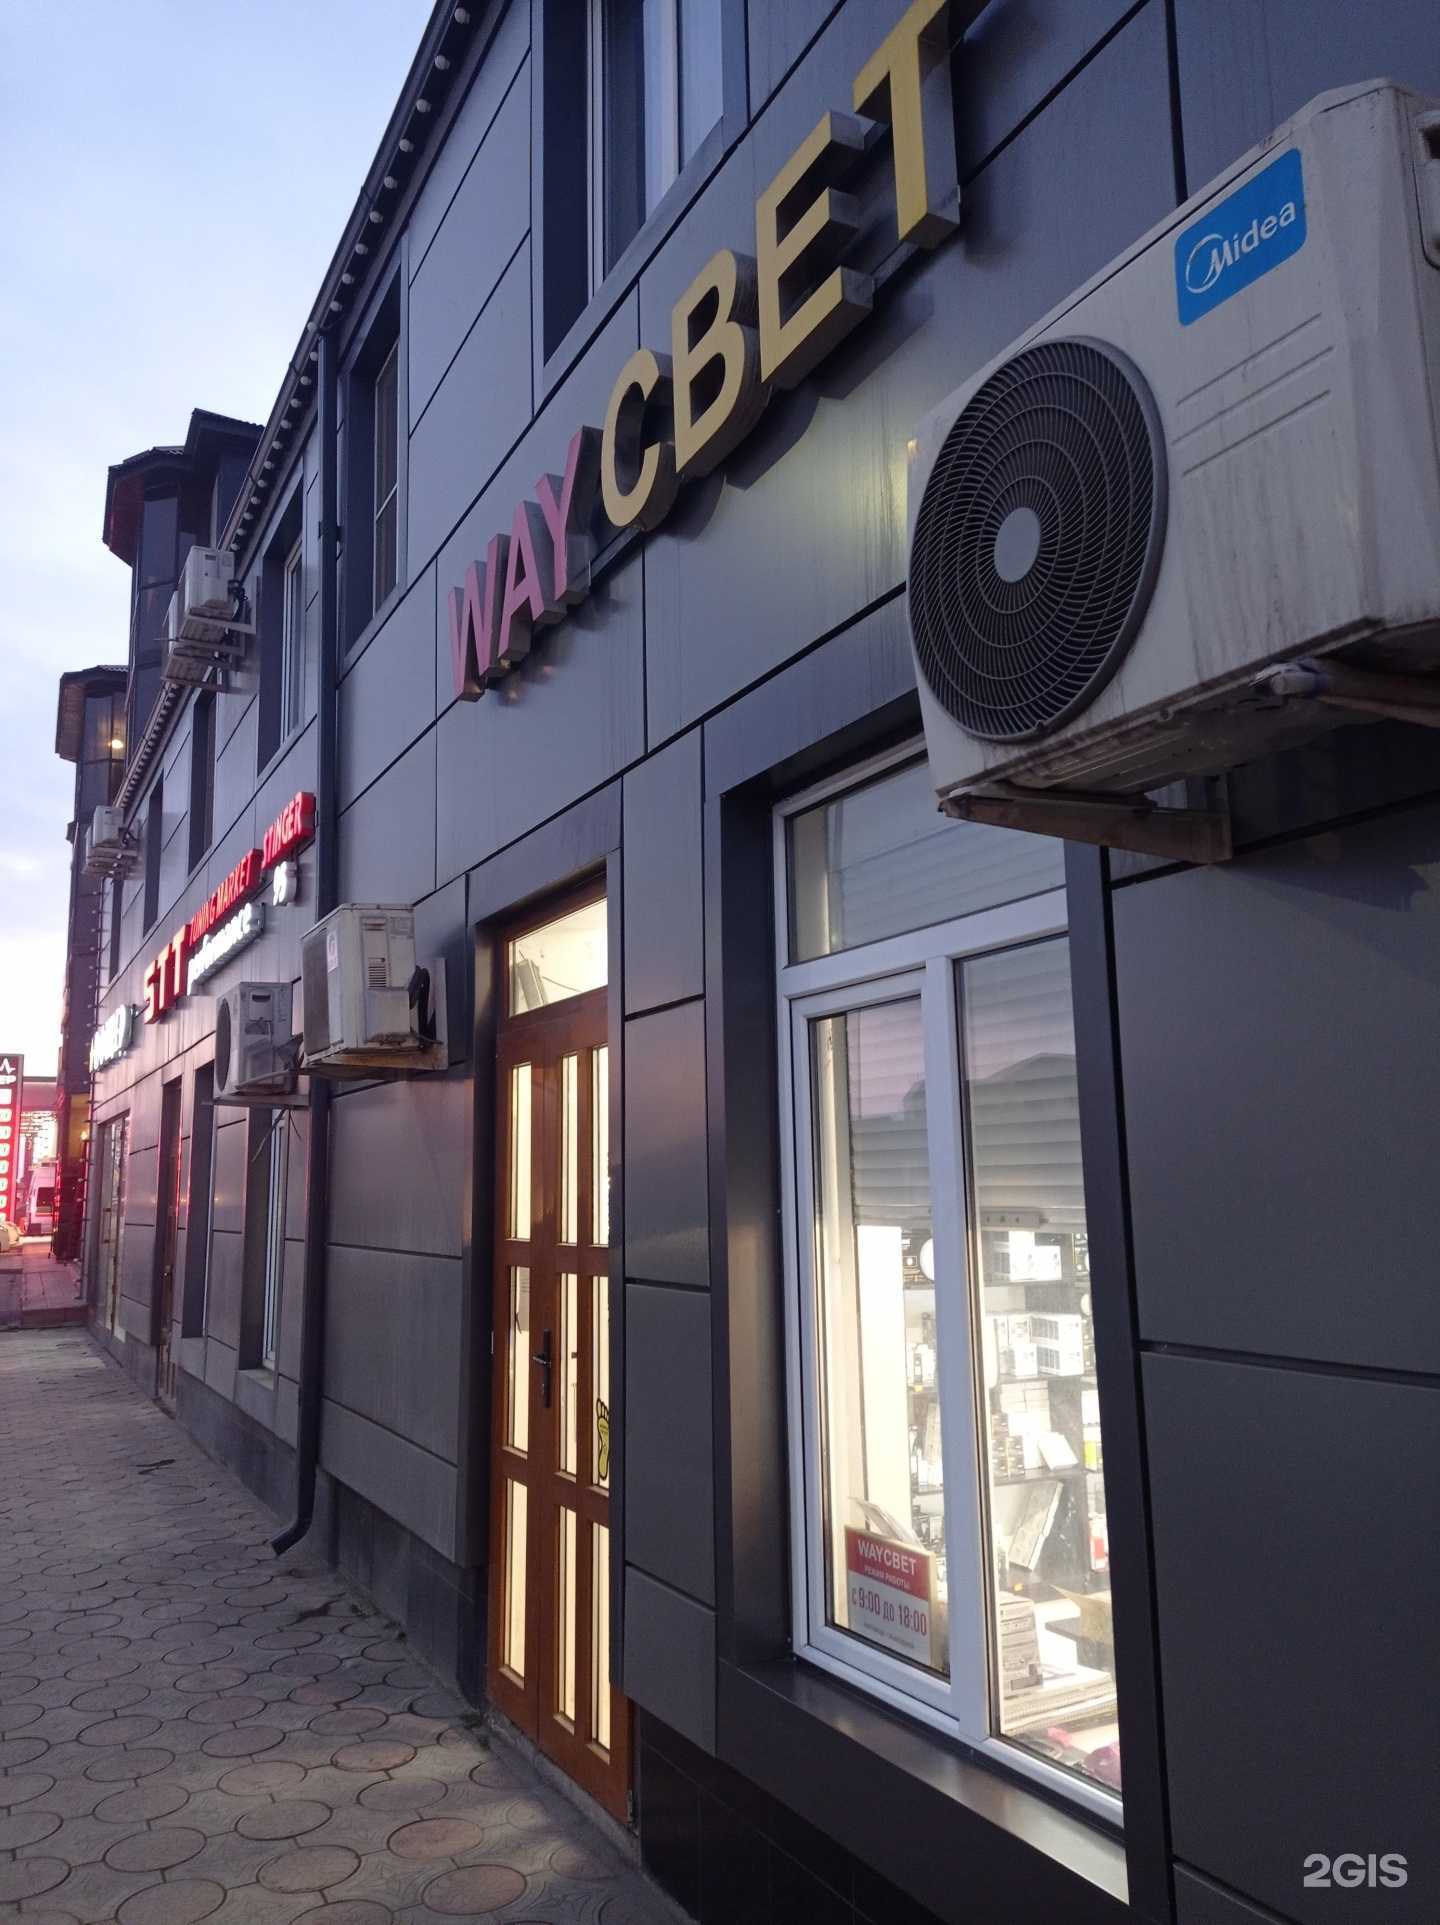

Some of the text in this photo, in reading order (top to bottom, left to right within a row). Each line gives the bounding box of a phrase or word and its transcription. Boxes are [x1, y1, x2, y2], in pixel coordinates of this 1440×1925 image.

[1186, 201, 1297, 293] Midea
[261, 791, 303, 869] STINGER
[216, 848, 254, 920] MARKET
[143, 924, 188, 1024] STT
[858, 1586, 881, 1616] 9:00
[898, 1603, 928, 1637] 18:00
